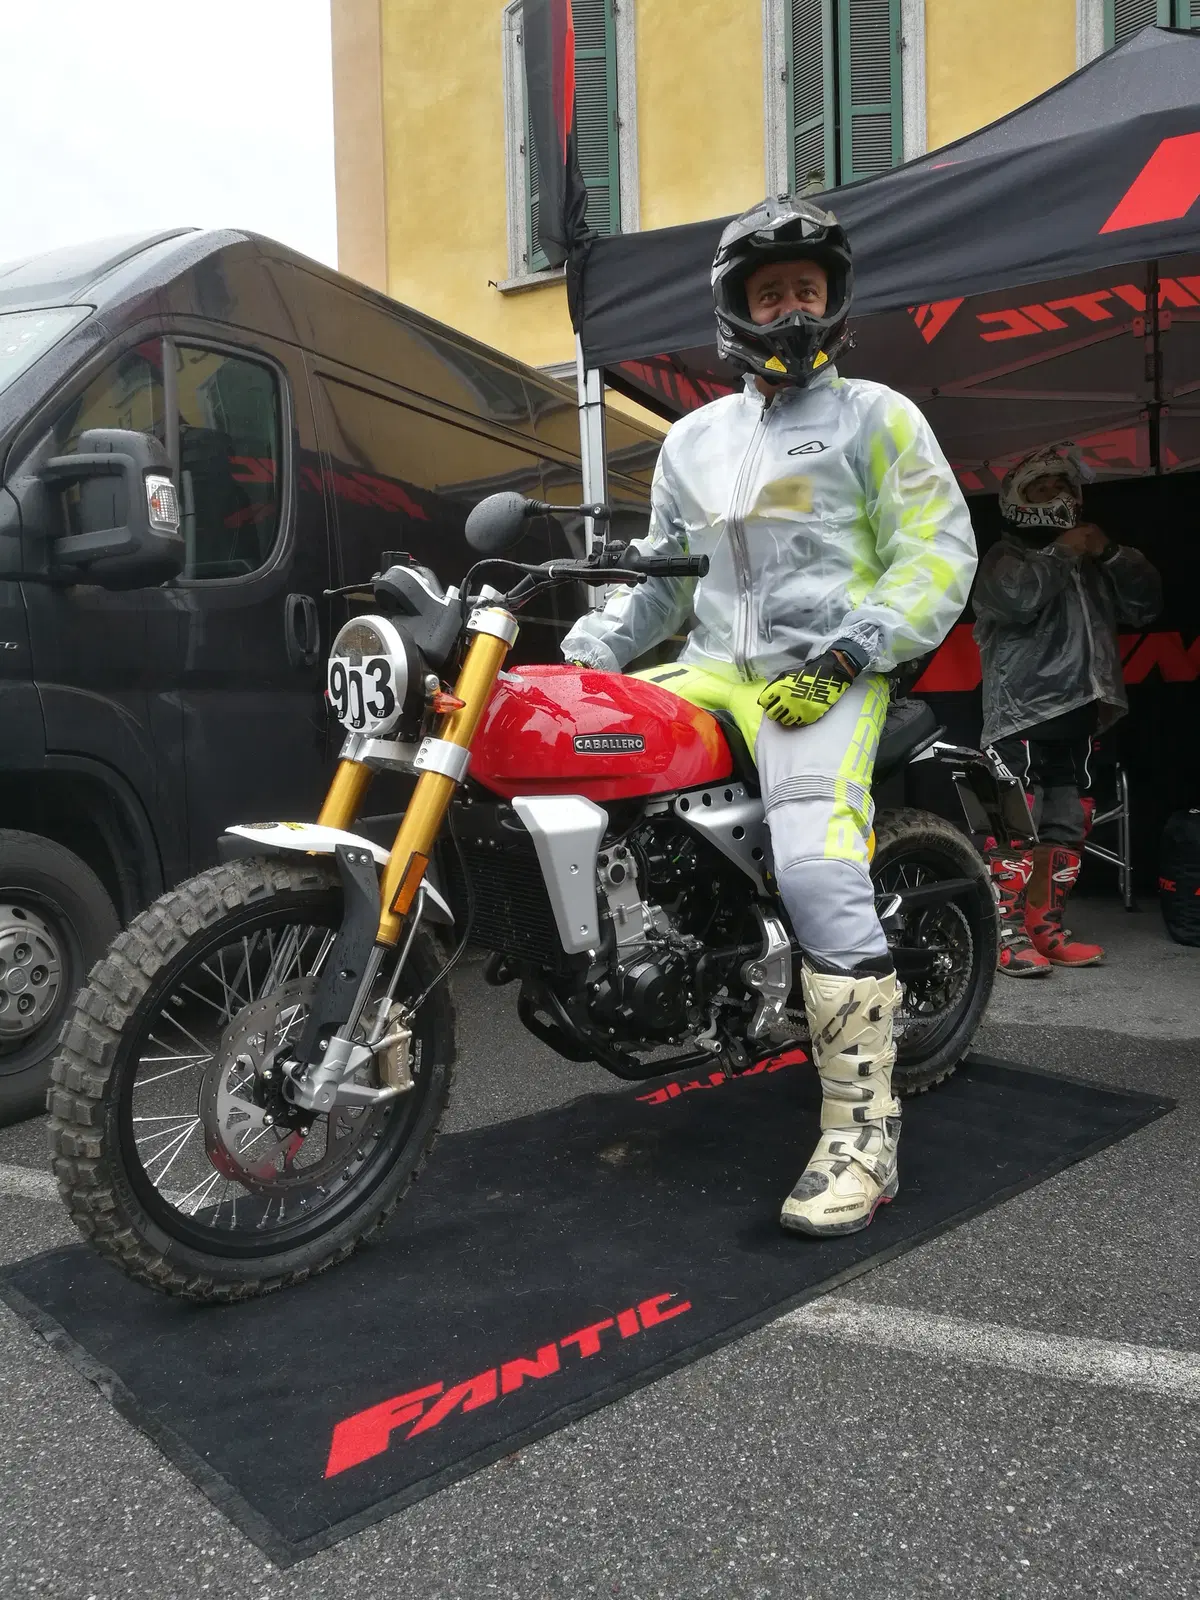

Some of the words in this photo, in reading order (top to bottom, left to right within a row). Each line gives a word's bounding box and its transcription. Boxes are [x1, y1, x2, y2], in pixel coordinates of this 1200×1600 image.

[1006, 504, 1054, 525] Airoh
[330, 658, 395, 729] 903
[575, 739, 643, 749] CABALLERO
[325, 1292, 692, 1479] FANTIC
